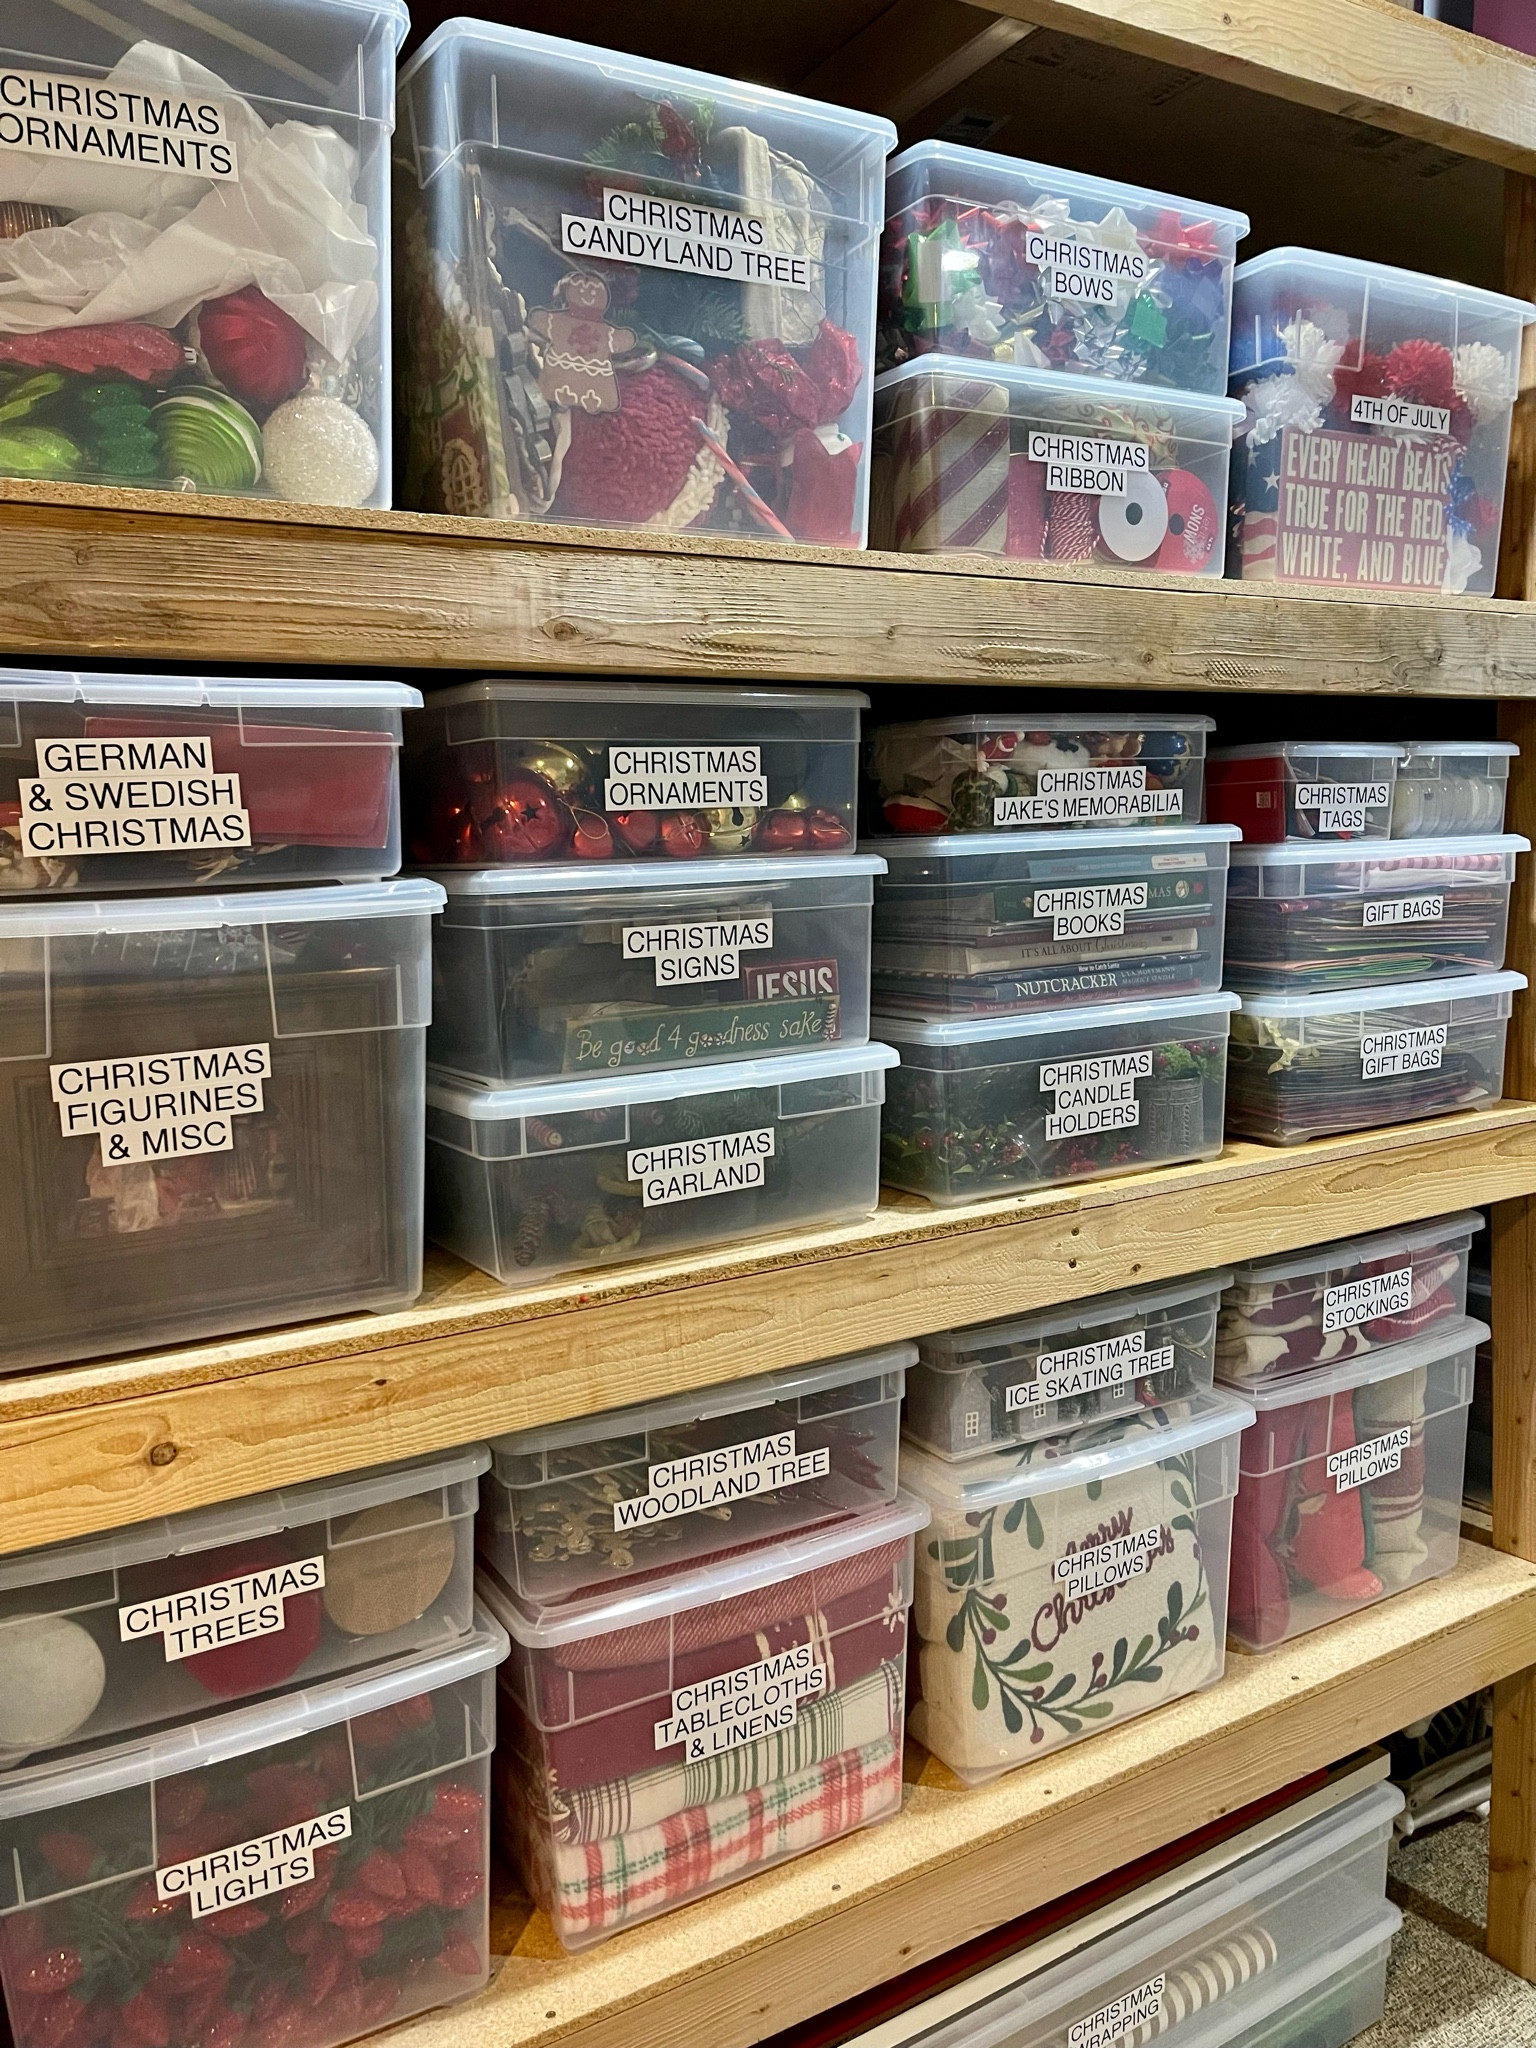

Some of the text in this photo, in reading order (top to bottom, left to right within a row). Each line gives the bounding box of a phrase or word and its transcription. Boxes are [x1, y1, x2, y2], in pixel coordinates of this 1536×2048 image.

[0, 75, 220, 135] CHRISTMAS
[0, 113, 232, 174] ORNAMENTS
[609, 194, 763, 245] CHRISTMAS
[567, 221, 805, 284] CANDYLAND TREE
[1030, 237, 1143, 278] CHRISTMAS
[1056, 272, 1113, 301] BOWS
[1354, 400, 1447, 430] 4TH OF JULY
[1032, 435, 1145, 467] CHRISTMAS
[1287, 433, 1451, 495] EVERY HEART BEATS
[1051, 466, 1123, 492] RIBBON
[1183, 504, 1205, 544] SNOW
[1285, 483, 1446, 544] TRUE FOR THE RED,
[1283, 532, 1445, 586] WHITE, AND BLUE
[45, 742, 206, 772] GERMAN
[614, 751, 756, 774] CHRISTMAS
[29, 779, 233, 812] & SWEDISH
[610, 780, 763, 806] ORNAMENTS
[1041, 770, 1143, 793] CHRISTMAS
[1298, 786, 1386, 805] CHRISTMAS
[997, 793, 1180, 821] JAKE'S MEMORABILIA
[1323, 810, 1362, 827] TAGS
[29, 815, 244, 850] CHRISTMAS
[1037, 886, 1144, 913] CHRISTMAS
[1366, 899, 1440, 922] GIFT BAGS
[628, 923, 768, 953] CHRISTMAS
[1058, 912, 1121, 936] BOOKS
[661, 954, 734, 981] SIGNS
[1041, 944, 1059, 956] ALL
[1061, 942, 1091, 954] ABOUT
[1015, 973, 1118, 997] NUTCRACKER
[576, 1030, 601, 1060] Be
[667, 1024, 682, 1049] 4
[686, 1016, 770, 1057] goodness
[1363, 1028, 1444, 1054] CHRISTMAS
[58, 1049, 264, 1095] CHRISTMAS
[1043, 1055, 1149, 1086] CHRISTMAS
[1366, 1049, 1439, 1075] GIFT BAGS
[68, 1083, 257, 1130] FIGURINES
[1059, 1082, 1131, 1109] CANDLE
[1050, 1105, 1136, 1136] HOLDERS
[109, 1121, 226, 1160] & MISC
[632, 1132, 770, 1174] CHRISTMAS
[647, 1163, 760, 1200] GARLAND
[1325, 1291, 1408, 1328] STOCKINGS
[1326, 1271, 1409, 1310] CHRISTMAS
[1040, 1335, 1142, 1376] CHRISTMAS
[1009, 1349, 1171, 1408] ICE SKATING TREE
[653, 1436, 791, 1488] CHRISTMAS
[1329, 1430, 1408, 1474] CHRISTMAS
[618, 1452, 825, 1525] WOODLAND TREE
[1339, 1454, 1398, 1490] PILLOWS
[1057, 1529, 1158, 1578] CHRISTMAS
[1068, 1555, 1143, 1597] PILLOWS
[127, 1563, 319, 1633] CHRISTMAS
[170, 1605, 279, 1652] TREES
[677, 1649, 809, 1711] CHRISTMAS
[659, 1669, 822, 1742] TABLECLOTHS
[691, 1705, 793, 1758] & LINENS
[163, 1814, 345, 1895] CHRISTMAS
[197, 1857, 308, 1912] LIGHTS
[1071, 1977, 1163, 2042] CHRISTMAS
